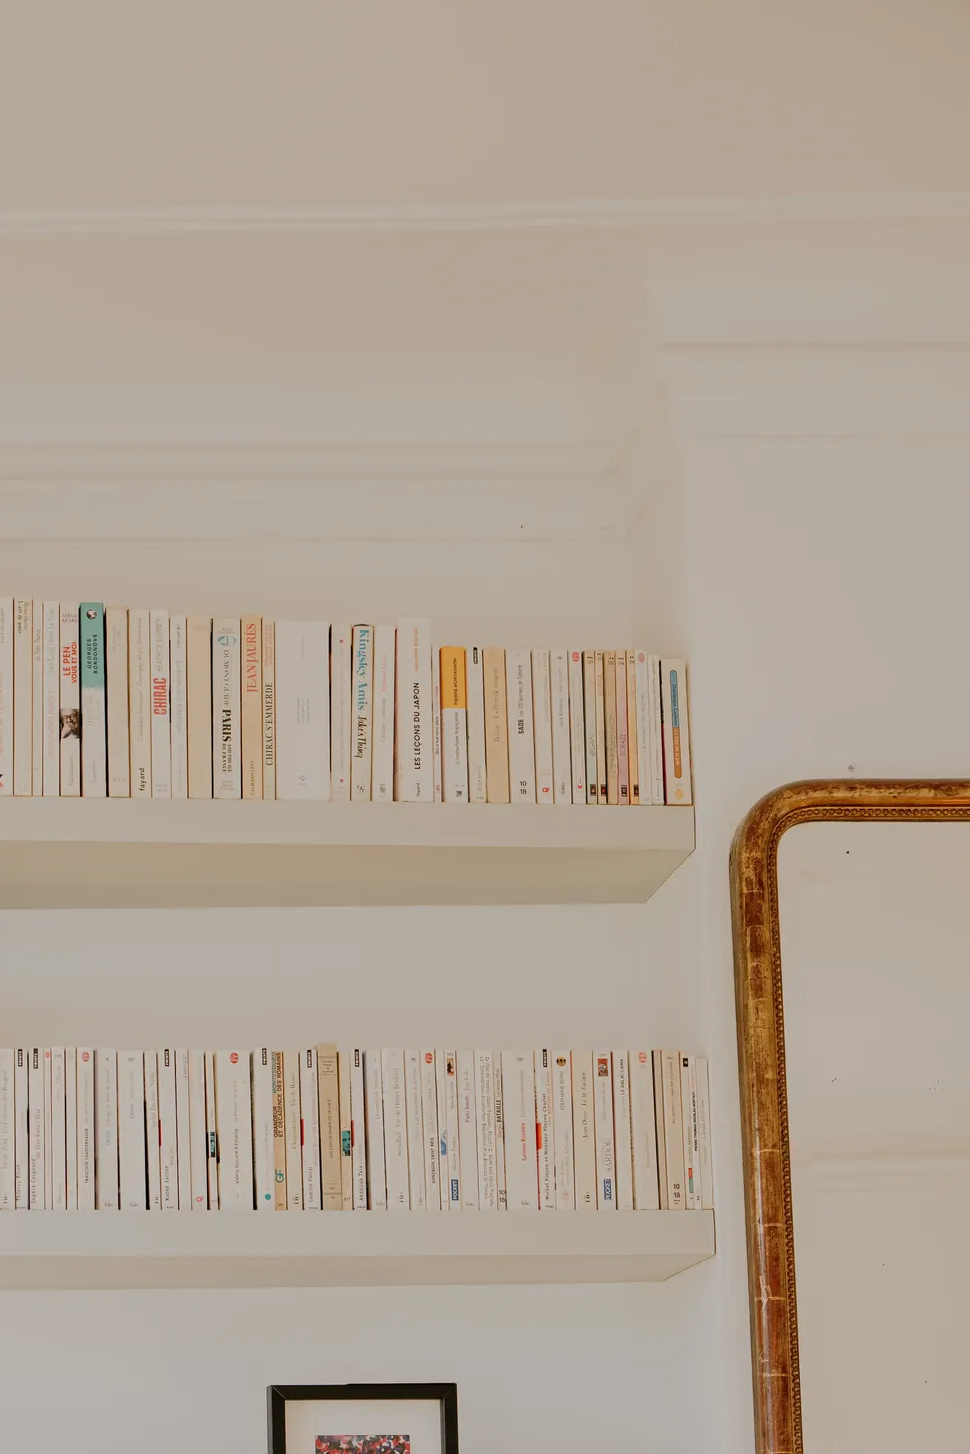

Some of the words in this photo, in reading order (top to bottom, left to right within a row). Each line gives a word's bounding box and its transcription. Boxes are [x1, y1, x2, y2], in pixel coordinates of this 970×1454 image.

[62, 646, 70, 664] PEN
[245, 623, 257, 663] JAURÈS
[358, 629, 370, 677] Kingsley
[63, 666, 70, 676] LE
[71, 656, 77, 664] ET
[245, 665, 258, 693] JEAN
[153, 677, 167, 715] CHIRAC
[264, 682, 273, 731] S'EMMERDE
[358, 683, 368, 710] Amis
[221, 709, 232, 742] PARIS
[358, 715, 368, 736] Jake's
[414, 711, 420, 722] DU
[517, 719, 525, 734] SADE
[265, 733, 273, 766] CHIRAC
[354, 738, 366, 758] Thing
[414, 724, 423, 756] LEÇONS
[619, 733, 627, 756] TOPAZE
[138, 767, 146, 792] fayard
[275, 1169, 284, 1183] GF
